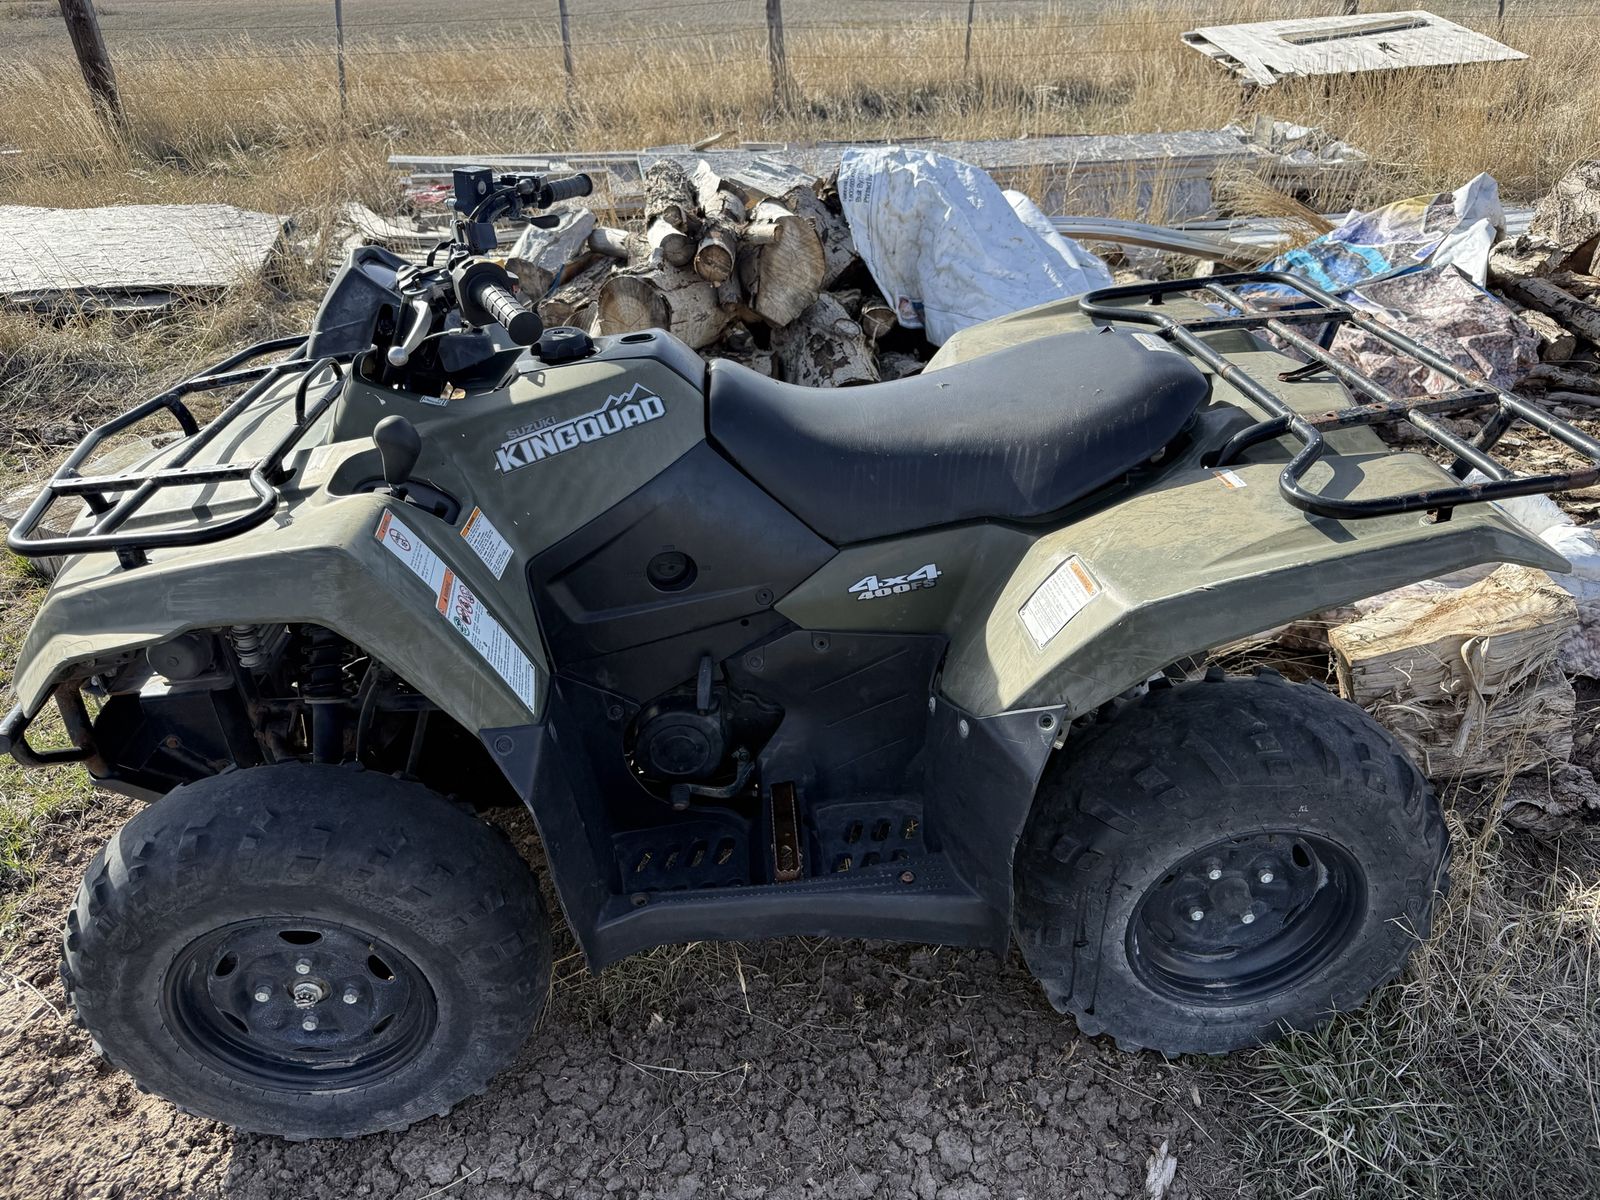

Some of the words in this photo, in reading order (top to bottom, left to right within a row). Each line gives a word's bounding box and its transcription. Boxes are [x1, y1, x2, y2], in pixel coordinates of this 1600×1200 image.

[495, 396, 667, 474] KINGQUAD
[506, 416, 557, 440] SUZUKI
[848, 563, 942, 593] 4x4
[858, 580, 936, 600] 400FS
